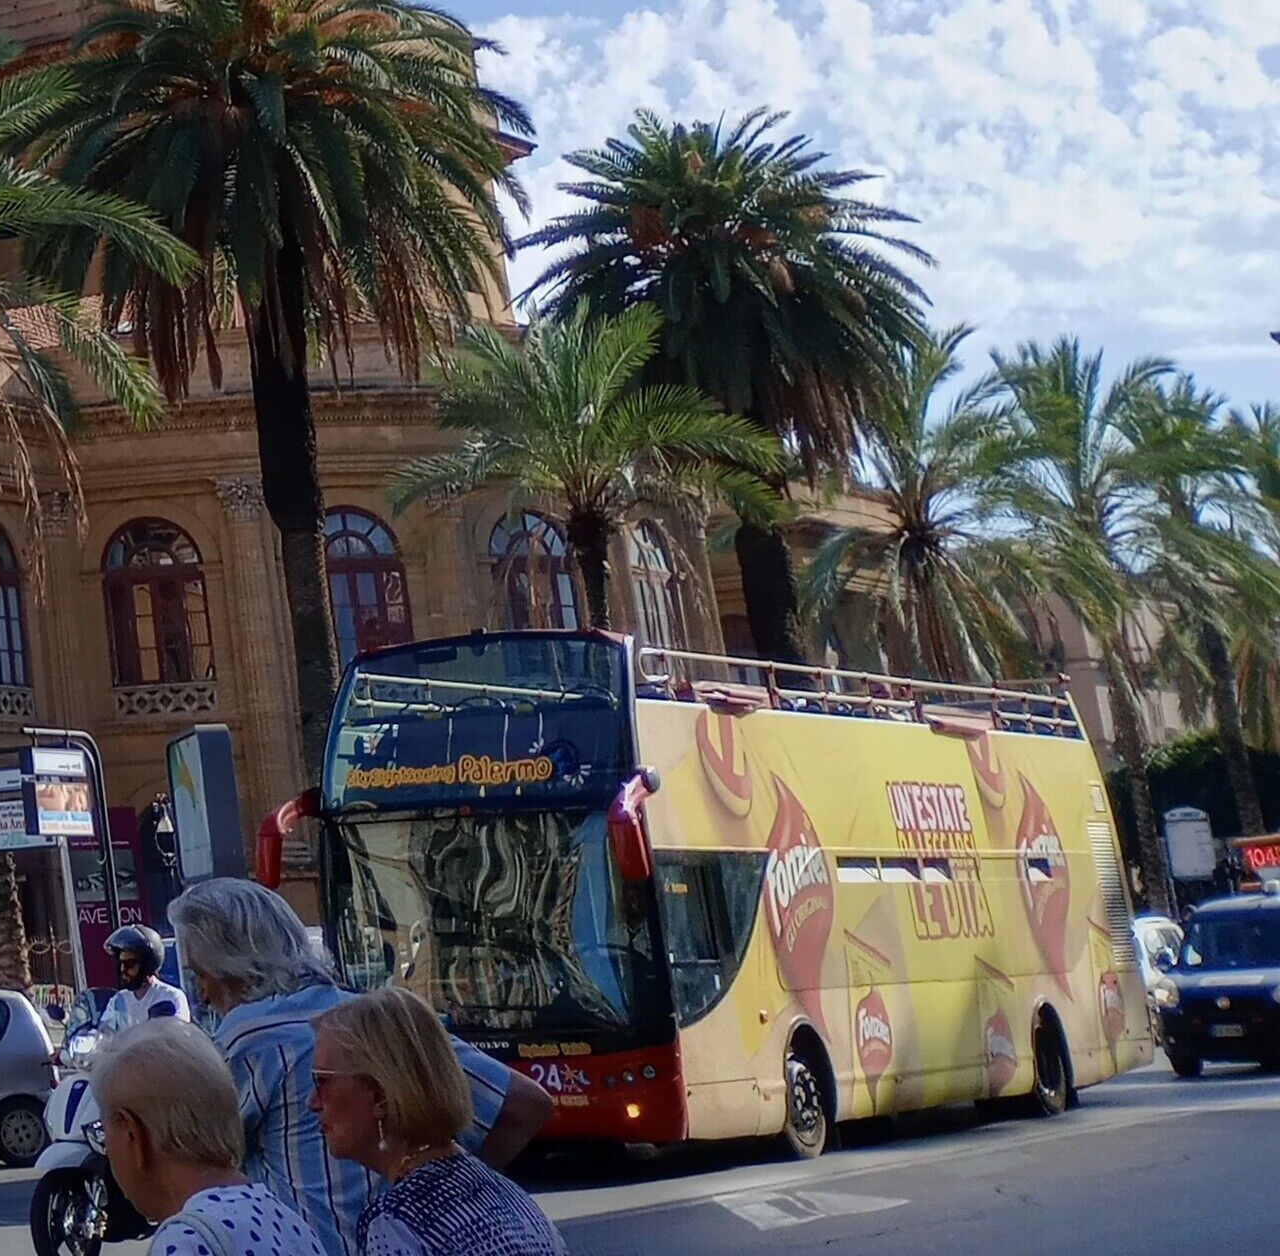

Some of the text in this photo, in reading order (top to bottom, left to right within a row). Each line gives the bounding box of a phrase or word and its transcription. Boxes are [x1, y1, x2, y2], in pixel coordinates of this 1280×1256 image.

[458, 754, 553, 785] Palermo
[886, 781, 973, 833] UN'ESTATE
[766, 834, 829, 938] Fonzies
[79, 907, 143, 924] AVEON
